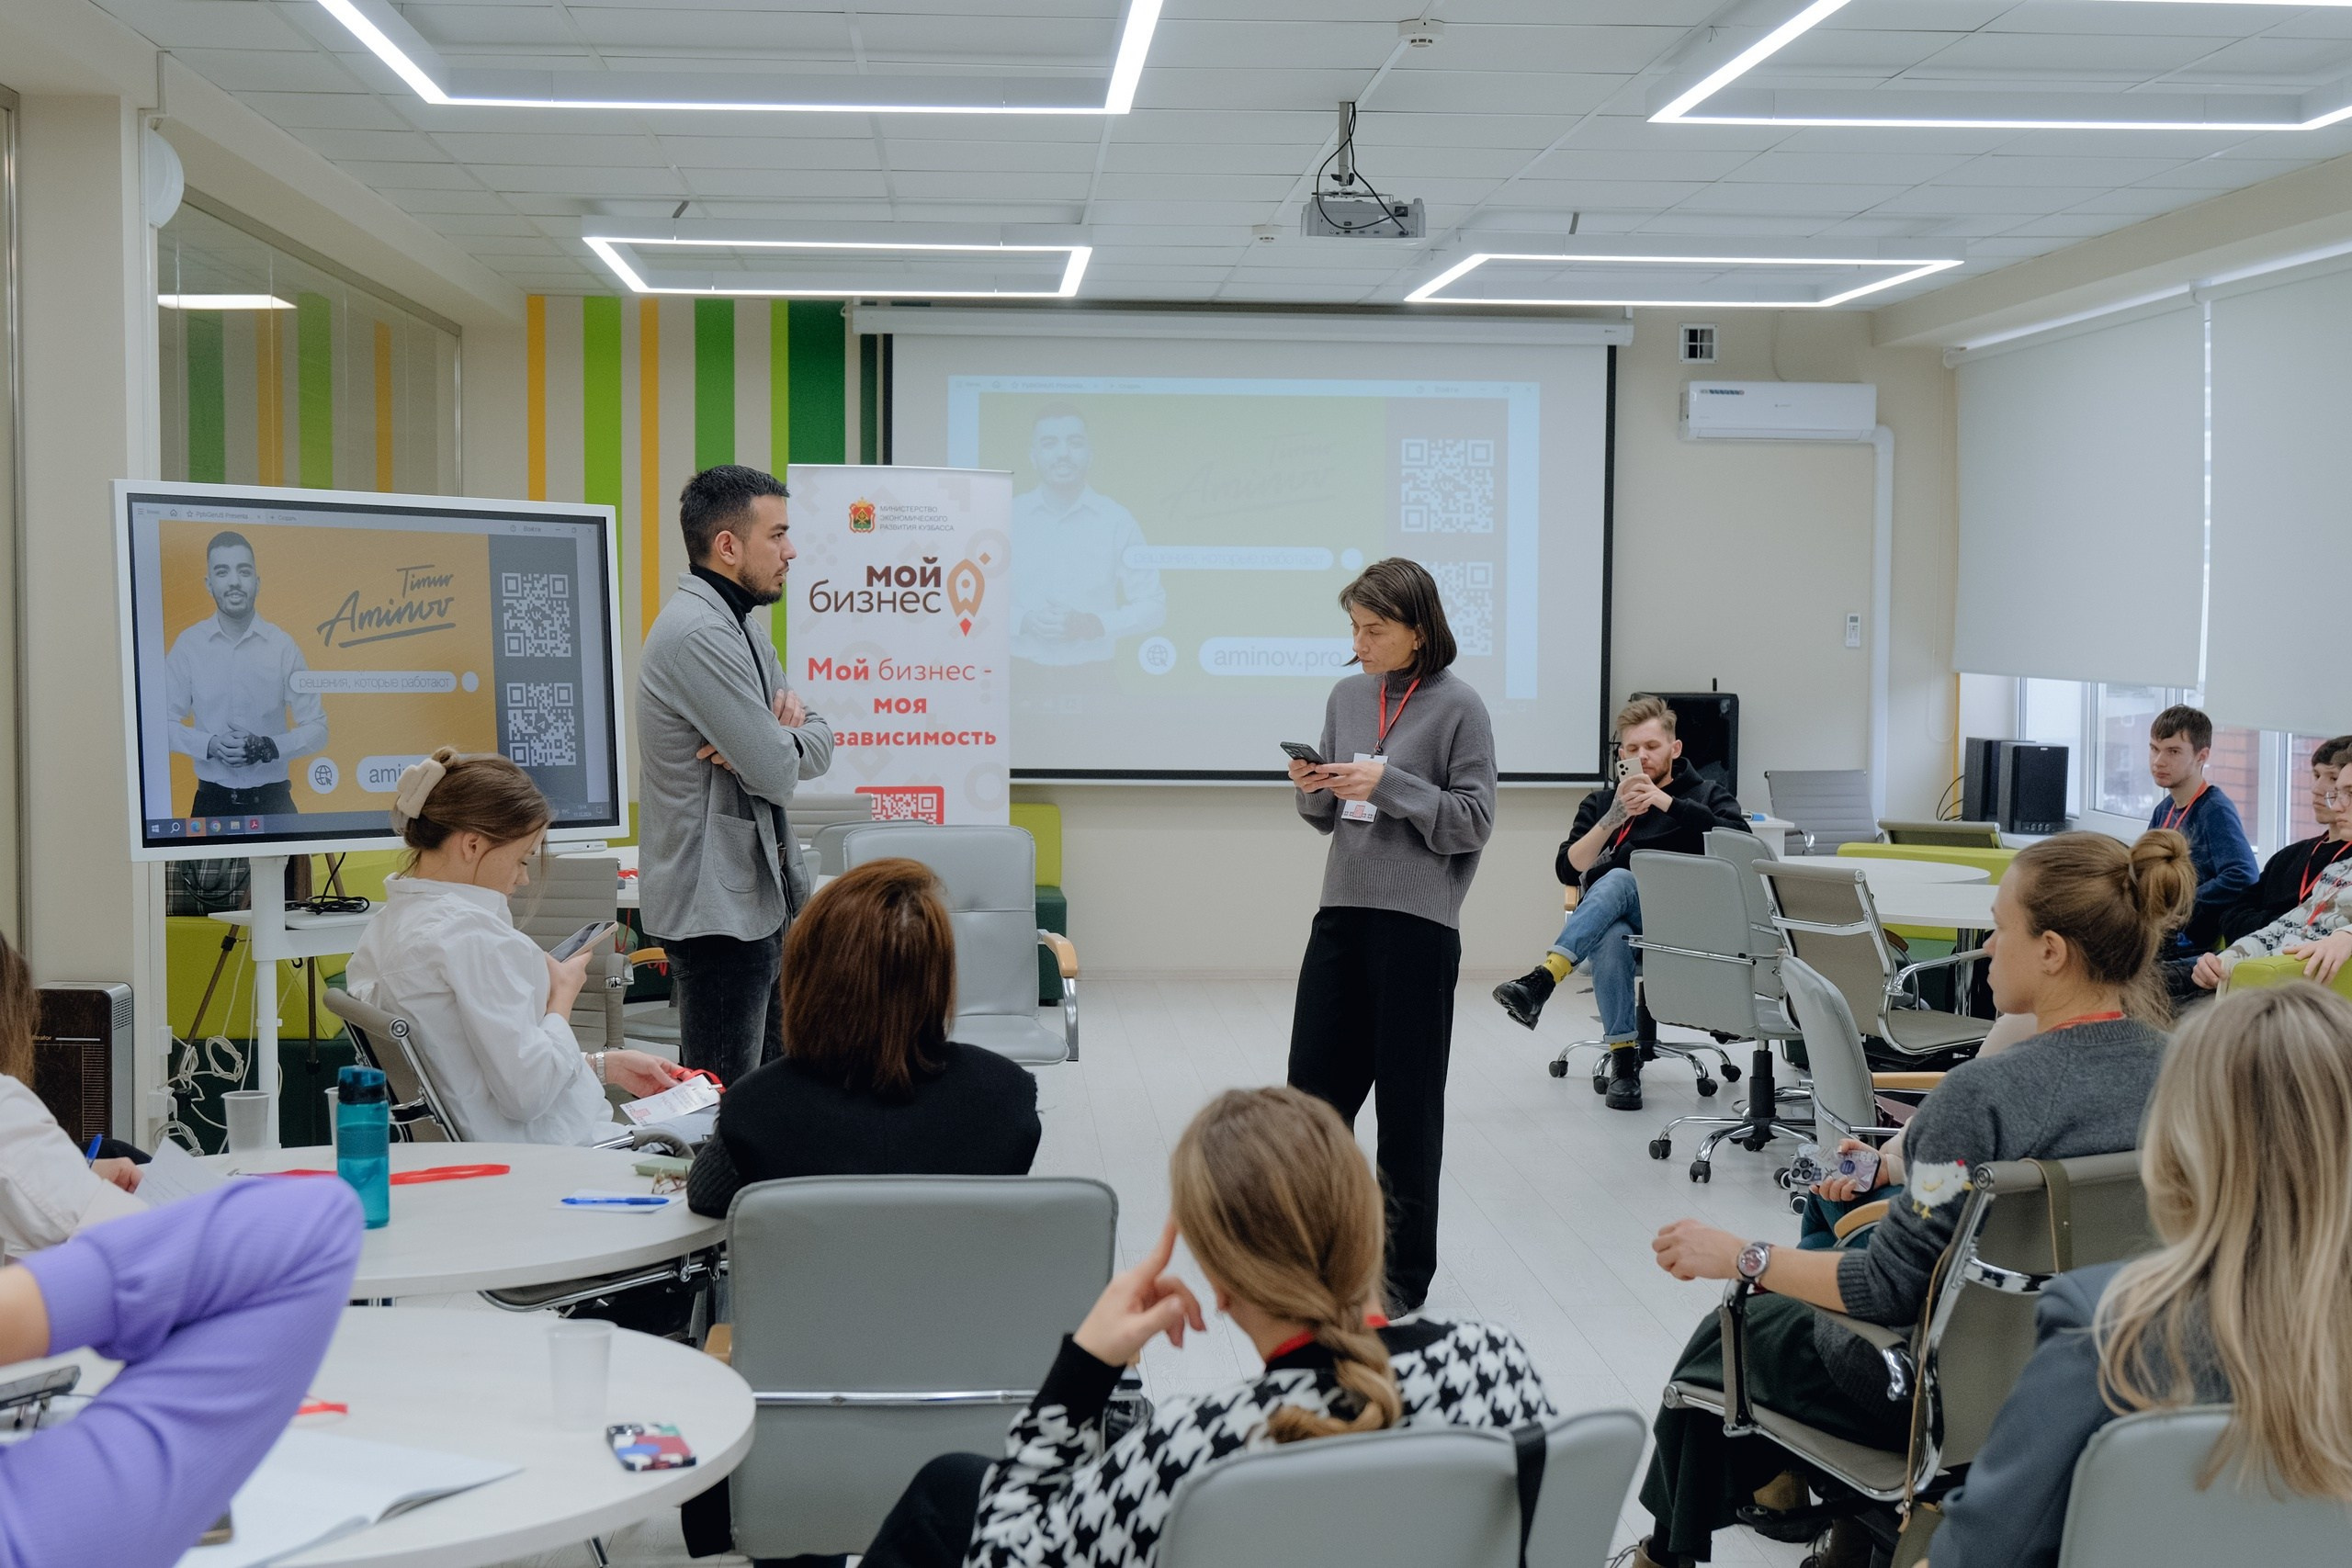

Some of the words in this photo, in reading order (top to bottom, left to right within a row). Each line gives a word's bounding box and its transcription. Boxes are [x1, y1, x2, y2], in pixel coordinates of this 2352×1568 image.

[397, 564, 454, 598] Timur
[866, 557, 941, 588] мой
[809, 580, 942, 614] бизнес
[316, 590, 455, 647] Aminov
[808, 657, 869, 682] Мой
[878, 658, 976, 681] бизнес
[1214, 647, 1342, 671] aminov.pro
[300, 676, 351, 689] решения,
[355, 676, 398, 689] которые
[401, 675, 450, 689] работают
[874, 698, 927, 714] моя
[834, 731, 997, 746] зависимость
[369, 763, 404, 784] ami
